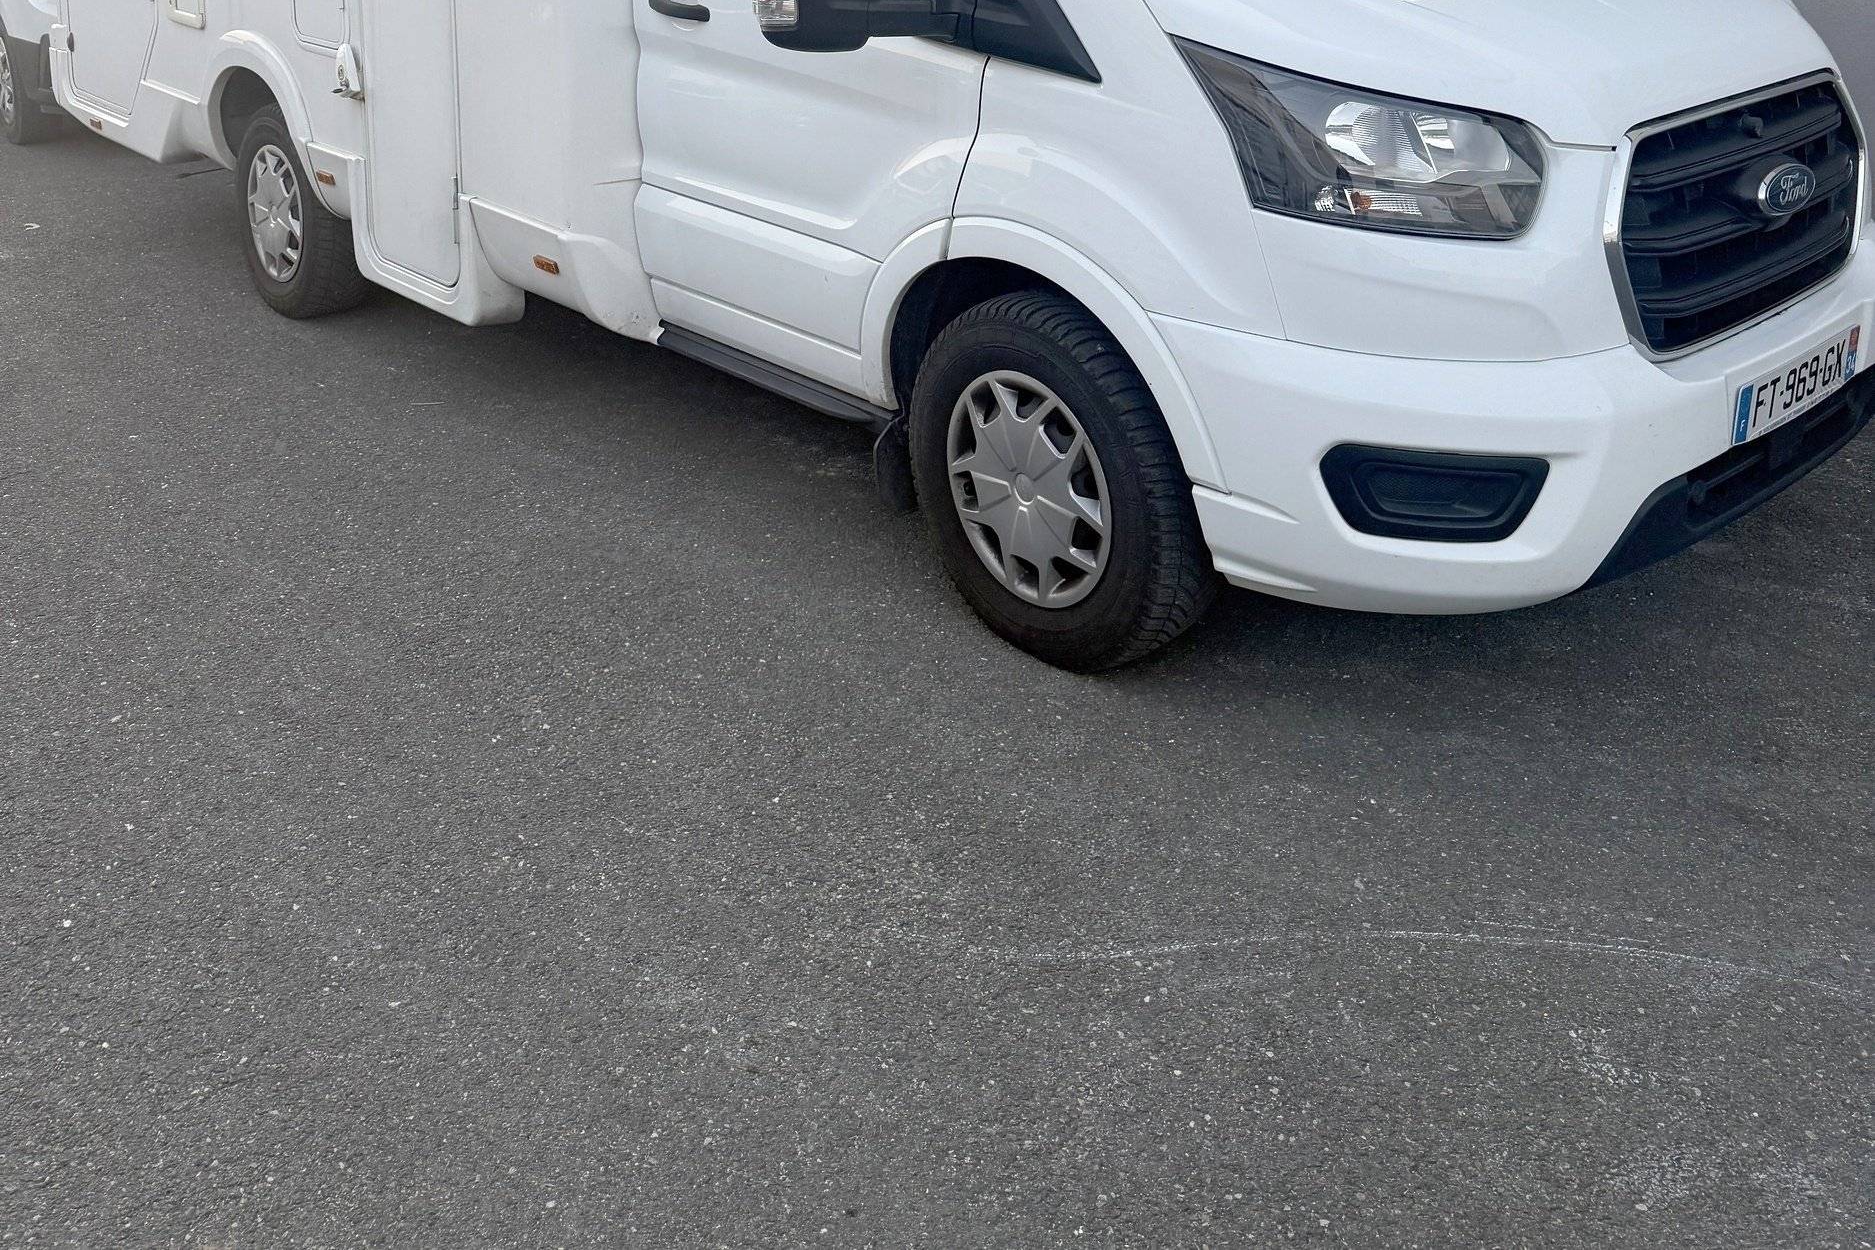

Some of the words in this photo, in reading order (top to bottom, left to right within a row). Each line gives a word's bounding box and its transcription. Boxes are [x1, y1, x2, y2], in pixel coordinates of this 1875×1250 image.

[1779, 172, 1809, 206] Ford
[1753, 339, 1846, 428] FT-969-GX
[1739, 418, 1746, 432] F
